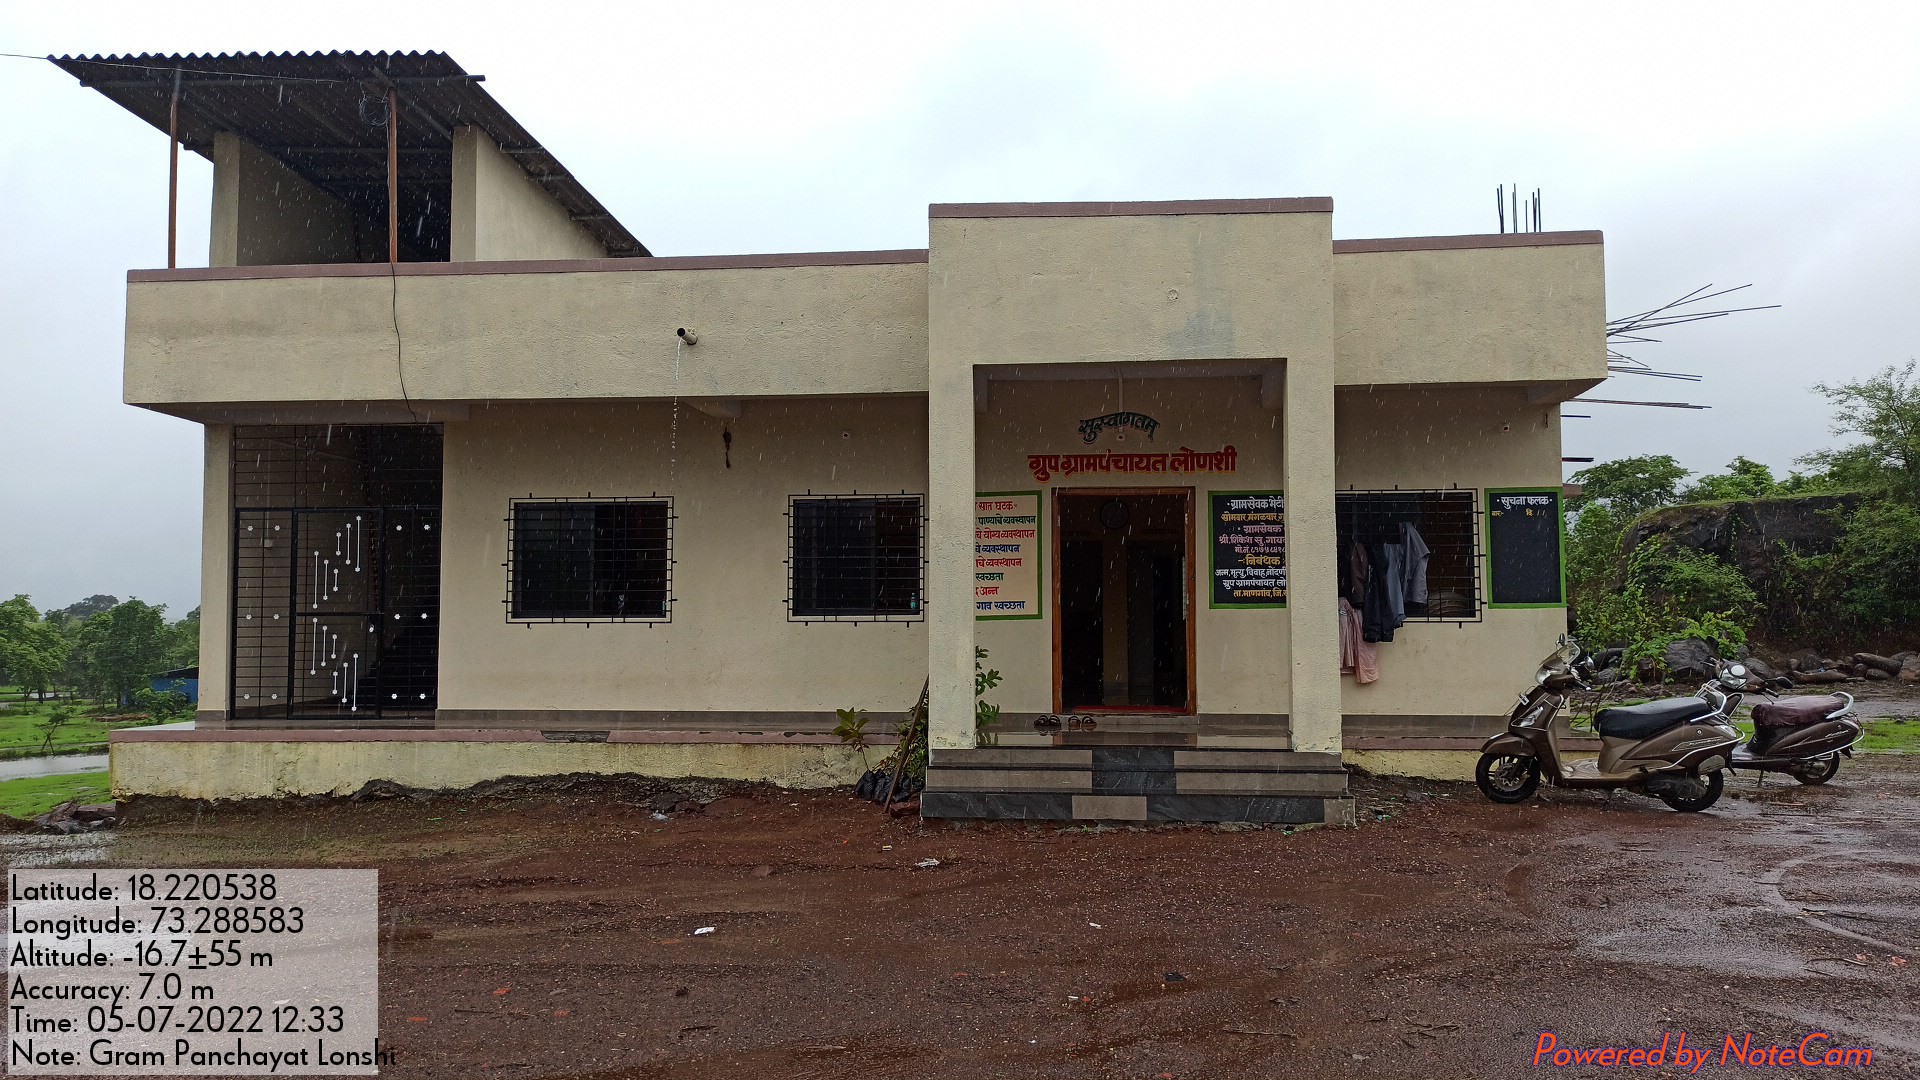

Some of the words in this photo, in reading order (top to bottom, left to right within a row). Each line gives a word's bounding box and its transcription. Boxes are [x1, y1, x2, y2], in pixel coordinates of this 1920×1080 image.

[1077, 411, 1160, 443] सुस्वागतम्
[1028, 454, 1060, 483] ग्रुप
[1060, 449, 1168, 478] ग्रामपंचायत
[1169, 445, 1238, 474] लोणशी
[1527, 496, 1549, 505] फलक
[982, 544, 1020, 554] व्यवस्थापन
[986, 558, 1022, 567] व्यवस्थापन
[1236, 578, 1275, 587] ग्रामपंचायत
